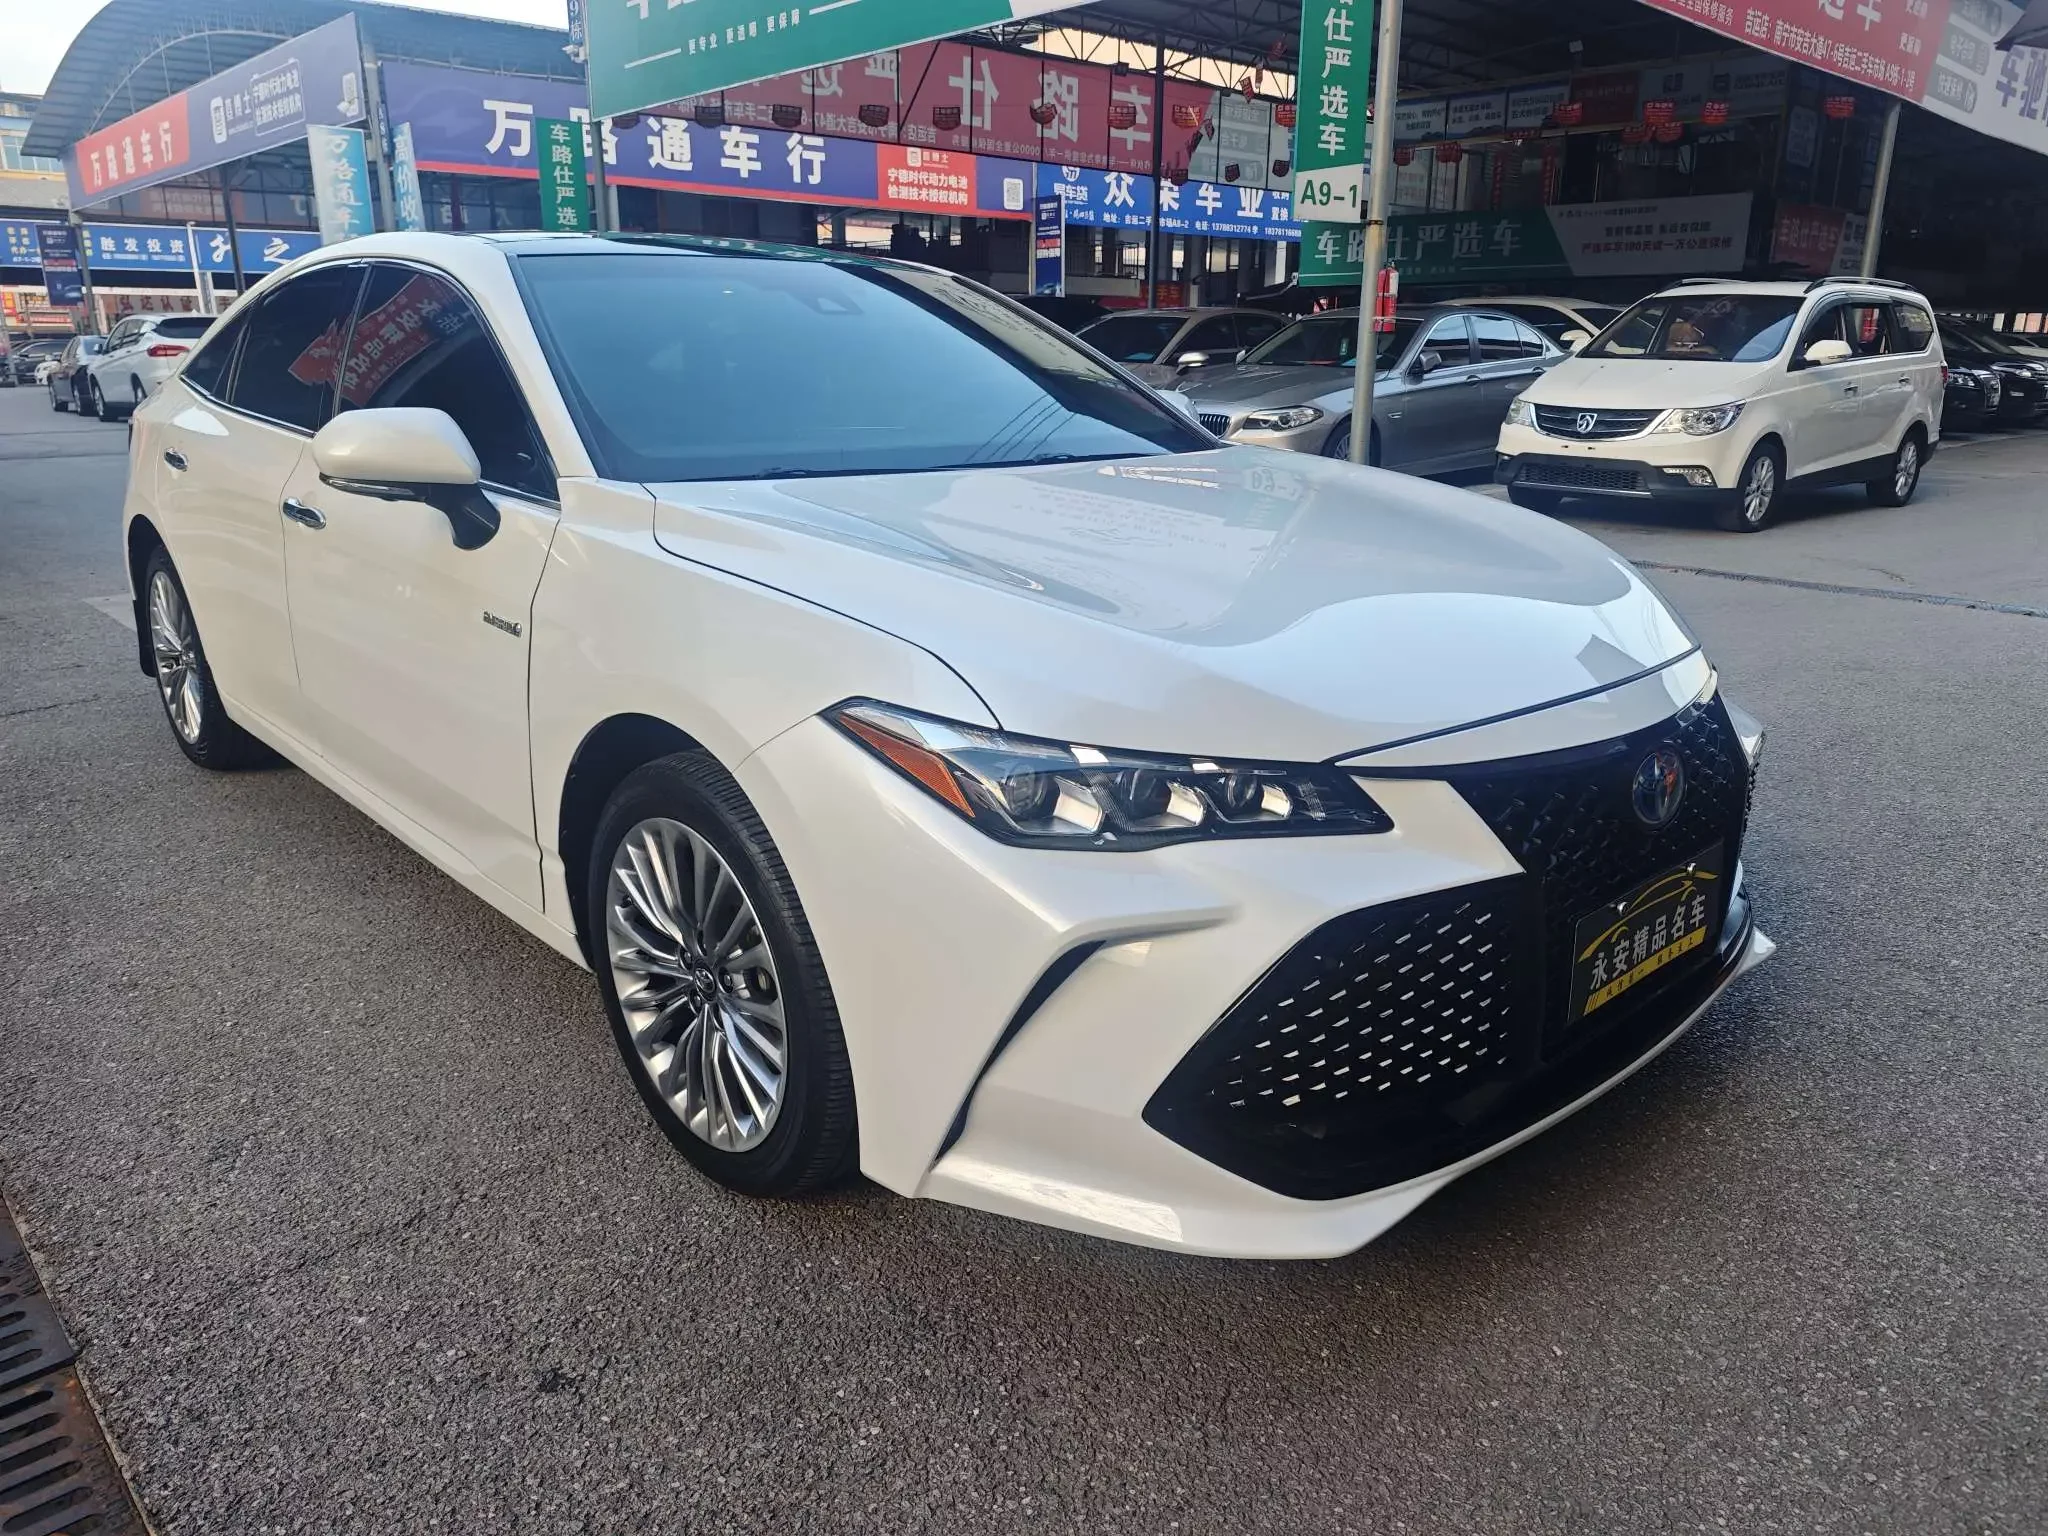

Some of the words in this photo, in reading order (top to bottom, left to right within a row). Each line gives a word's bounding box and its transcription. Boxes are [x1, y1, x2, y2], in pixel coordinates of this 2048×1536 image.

[1317, 0, 1355, 157] 仕严选车
[549, 124, 580, 231] 车路仕严选
[887, 167, 969, 190] 宁德时代动力电池
[1300, 179, 1358, 209] A9-1
[1590, 894, 1706, 991] 永安精品名车
